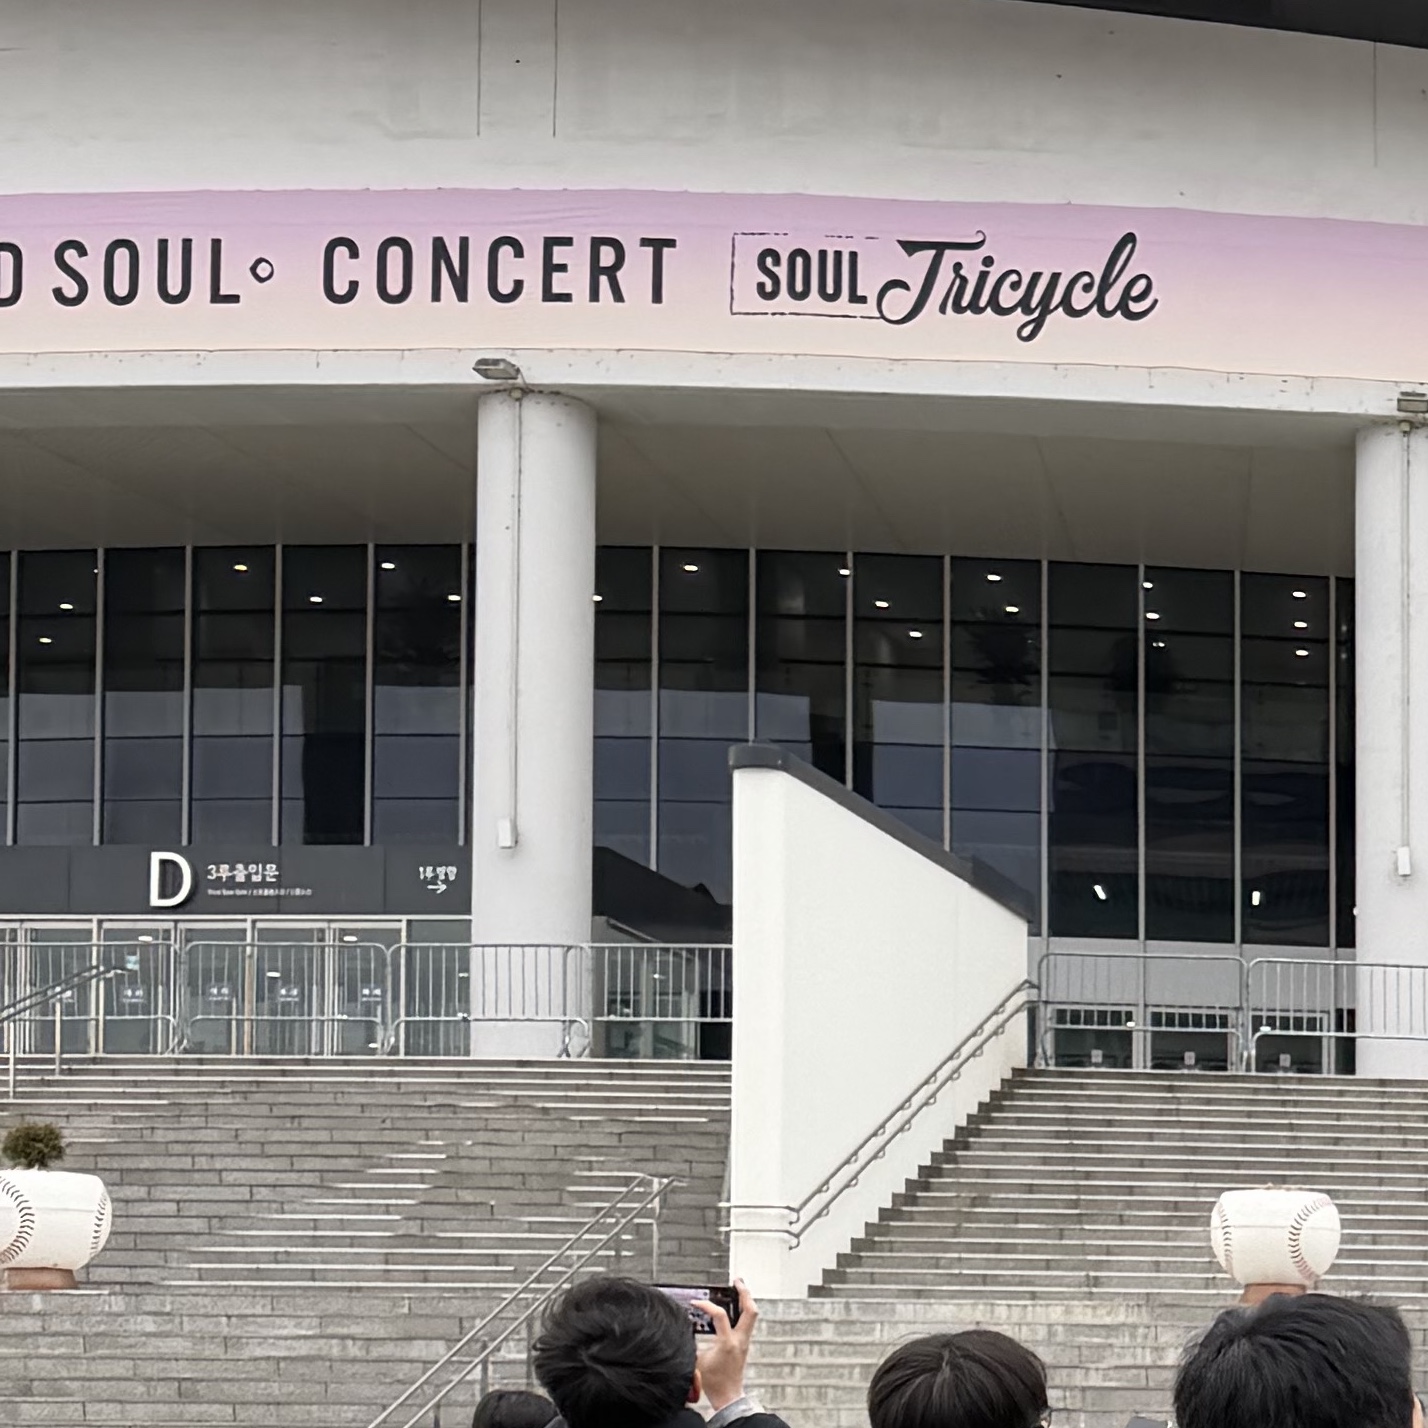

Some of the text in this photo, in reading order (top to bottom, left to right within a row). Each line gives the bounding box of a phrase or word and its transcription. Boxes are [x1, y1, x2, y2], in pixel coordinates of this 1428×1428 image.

[52, 238, 241, 306] SOUL
[322, 236, 679, 304] CONCERT
[756, 247, 869, 305] SOUL
[876, 230, 1159, 344] Tricycle
[150, 851, 192, 907] D
